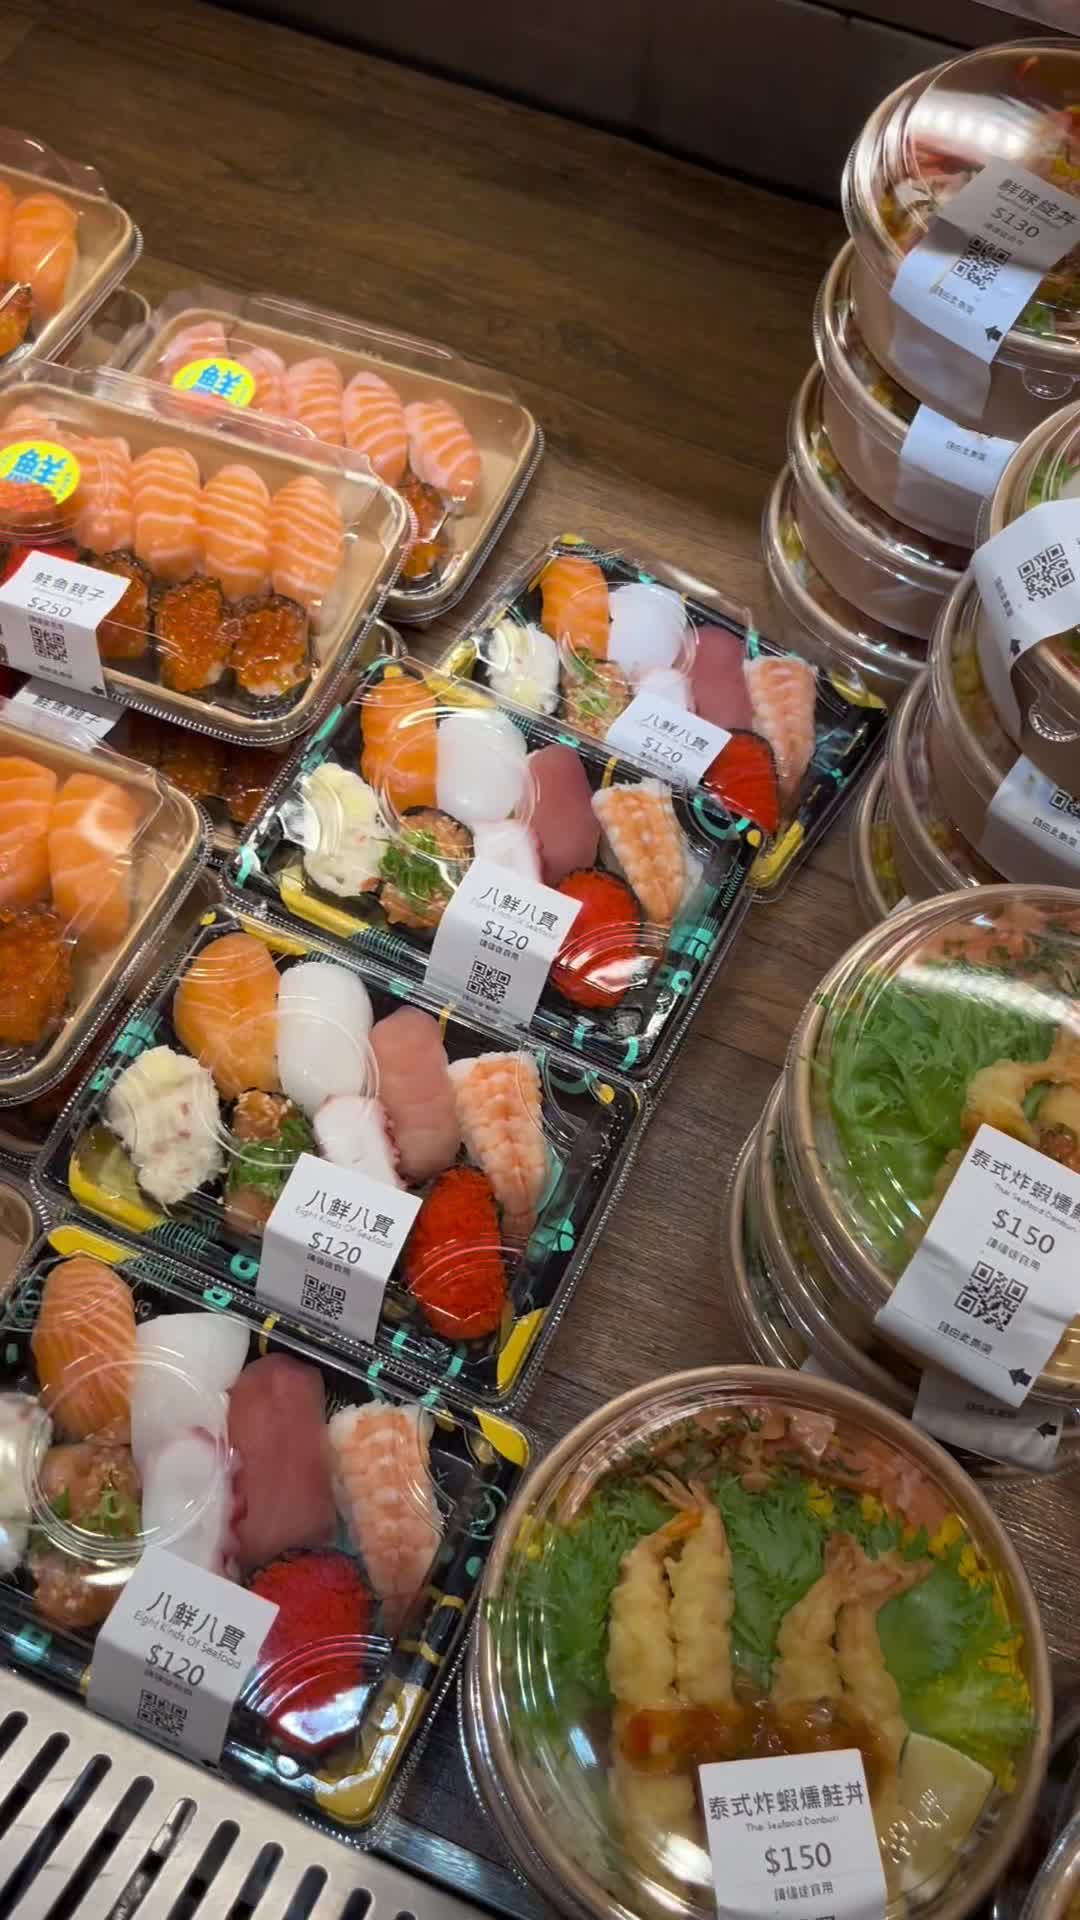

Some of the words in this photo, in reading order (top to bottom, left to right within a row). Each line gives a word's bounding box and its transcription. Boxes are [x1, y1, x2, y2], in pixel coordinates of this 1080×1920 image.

[991, 207, 1040, 238] $130
[32, 572, 105, 601] 鮭魚親子
[27, 596, 72, 618] $250
[641, 736, 683, 764] $120
[479, 887, 559, 931] 八鮮八貫
[481, 920, 529, 950] $120
[305, 1190, 395, 1238] 八鮮八貫
[992, 1208, 1055, 1254] $150
[307, 1231, 362, 1264] $120
[134, 1609, 160, 1629] Eight
[160, 1622, 186, 1642] Kinds
[187, 1635, 201, 1649] Of
[201, 1642, 242, 1670] Seafood
[146, 1591, 247, 1656] 八鮮八貫
[145, 1643, 205, 1687] $120
[708, 1780, 864, 1821] 泰式炸蝦燻鮭丼
[764, 1842, 831, 1877] $150
